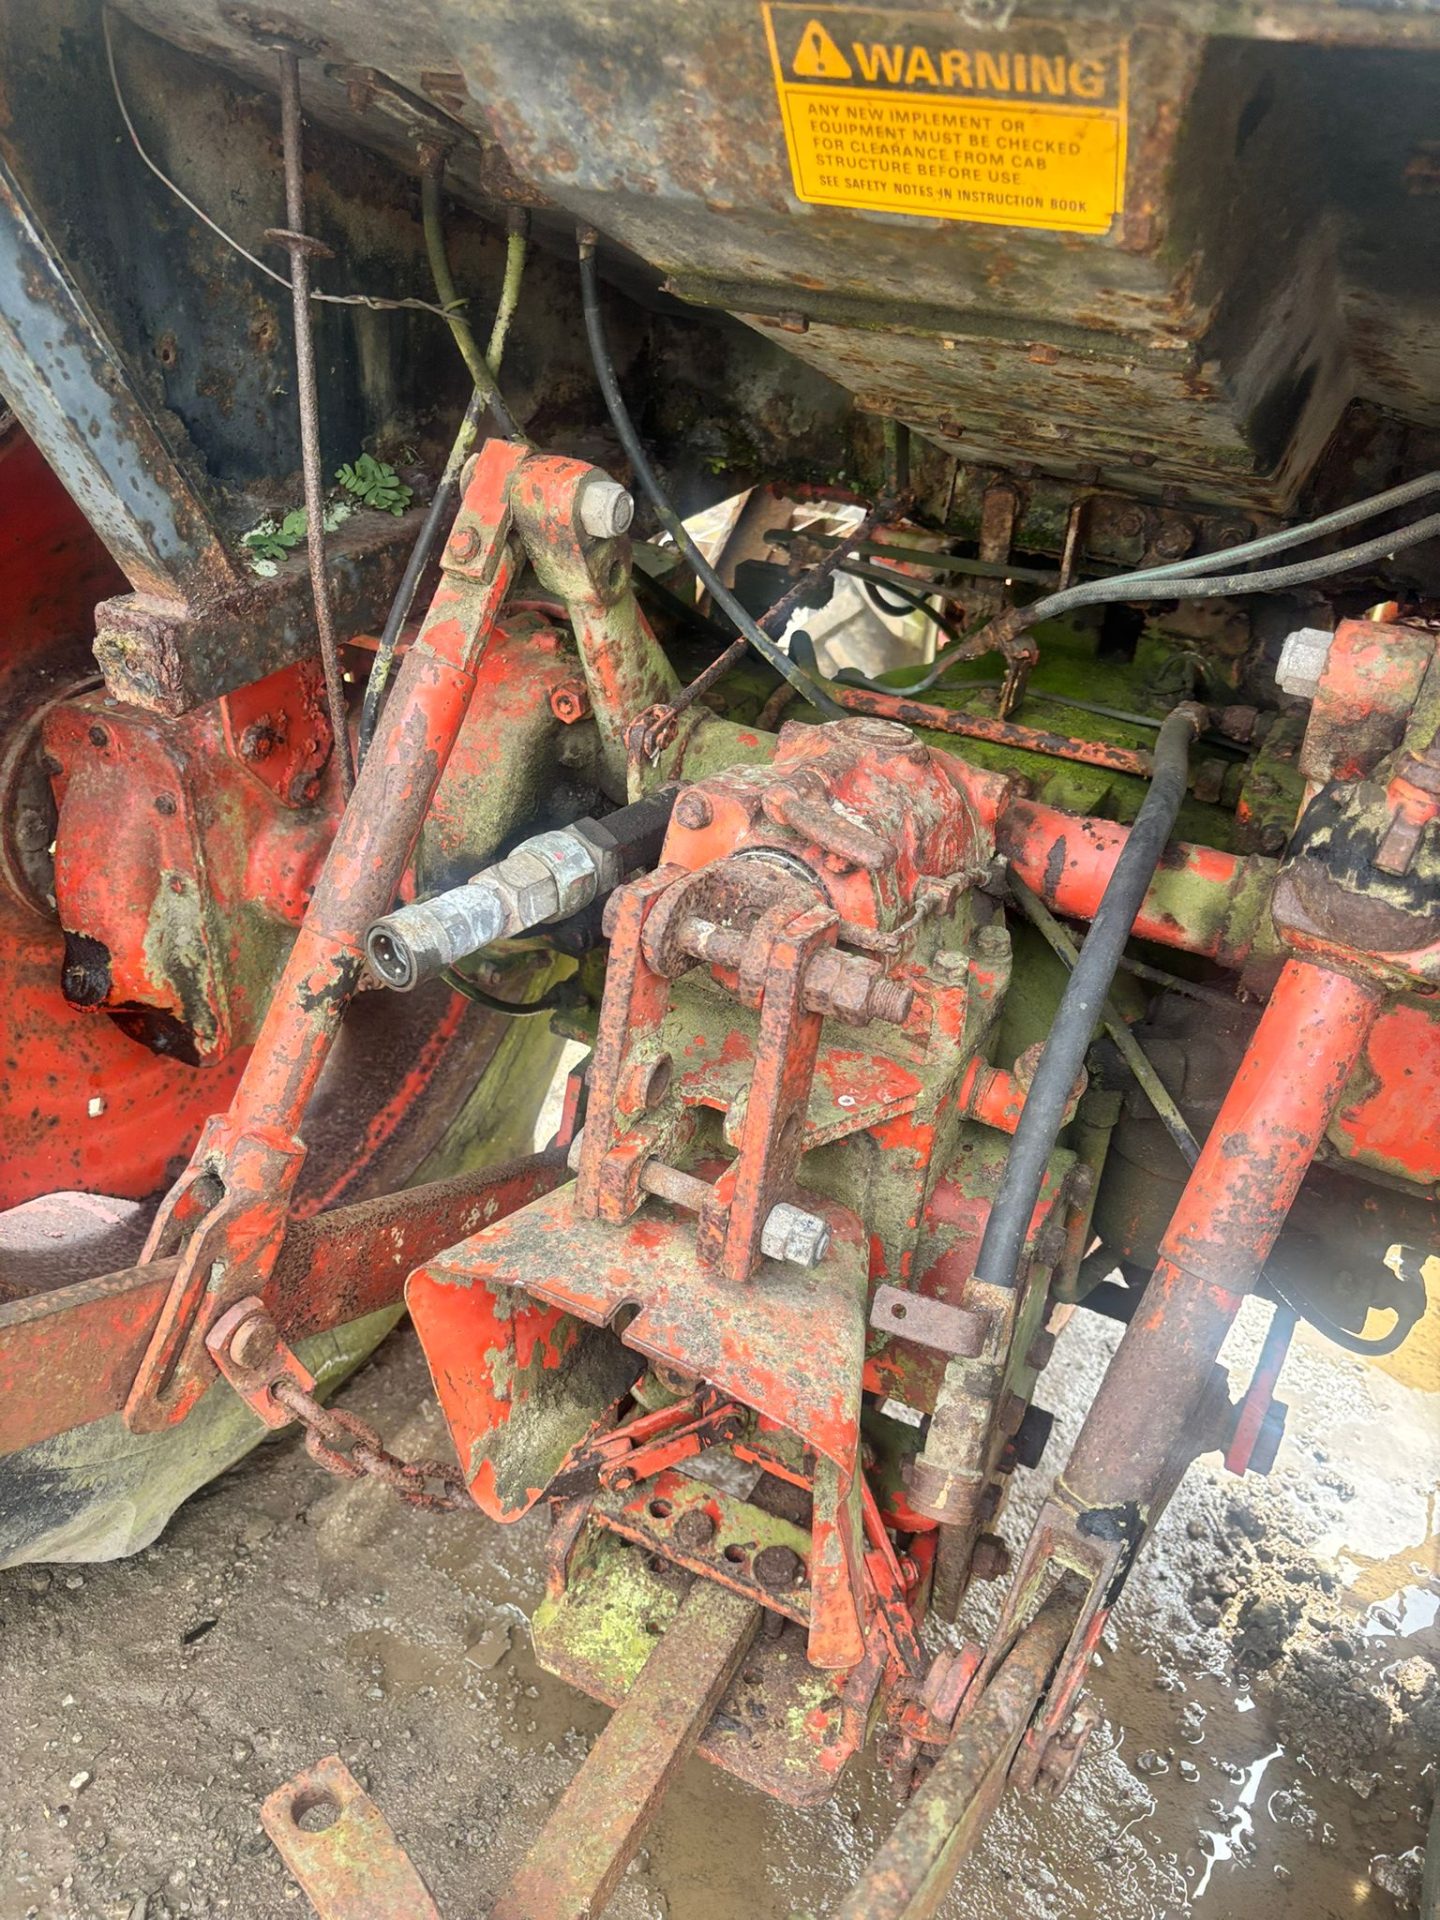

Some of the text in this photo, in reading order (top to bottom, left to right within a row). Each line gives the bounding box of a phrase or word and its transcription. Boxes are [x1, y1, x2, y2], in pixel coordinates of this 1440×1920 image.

[852, 42, 1105, 97] WARNING
[808, 103, 1025, 133] ANY NEW IMPLEMENT OR
[810, 120, 1081, 156] EQUIPMENT MUST BE CHECKED
[813, 137, 1047, 170] FOR CLEARANCE FROM CAB
[816, 154, 912, 174] STRUCTURE
[917, 164, 982, 181] BEFORE
[819, 175, 1087, 212] SEE SAFETY NOTES IN INSTRUCTION BOOK
